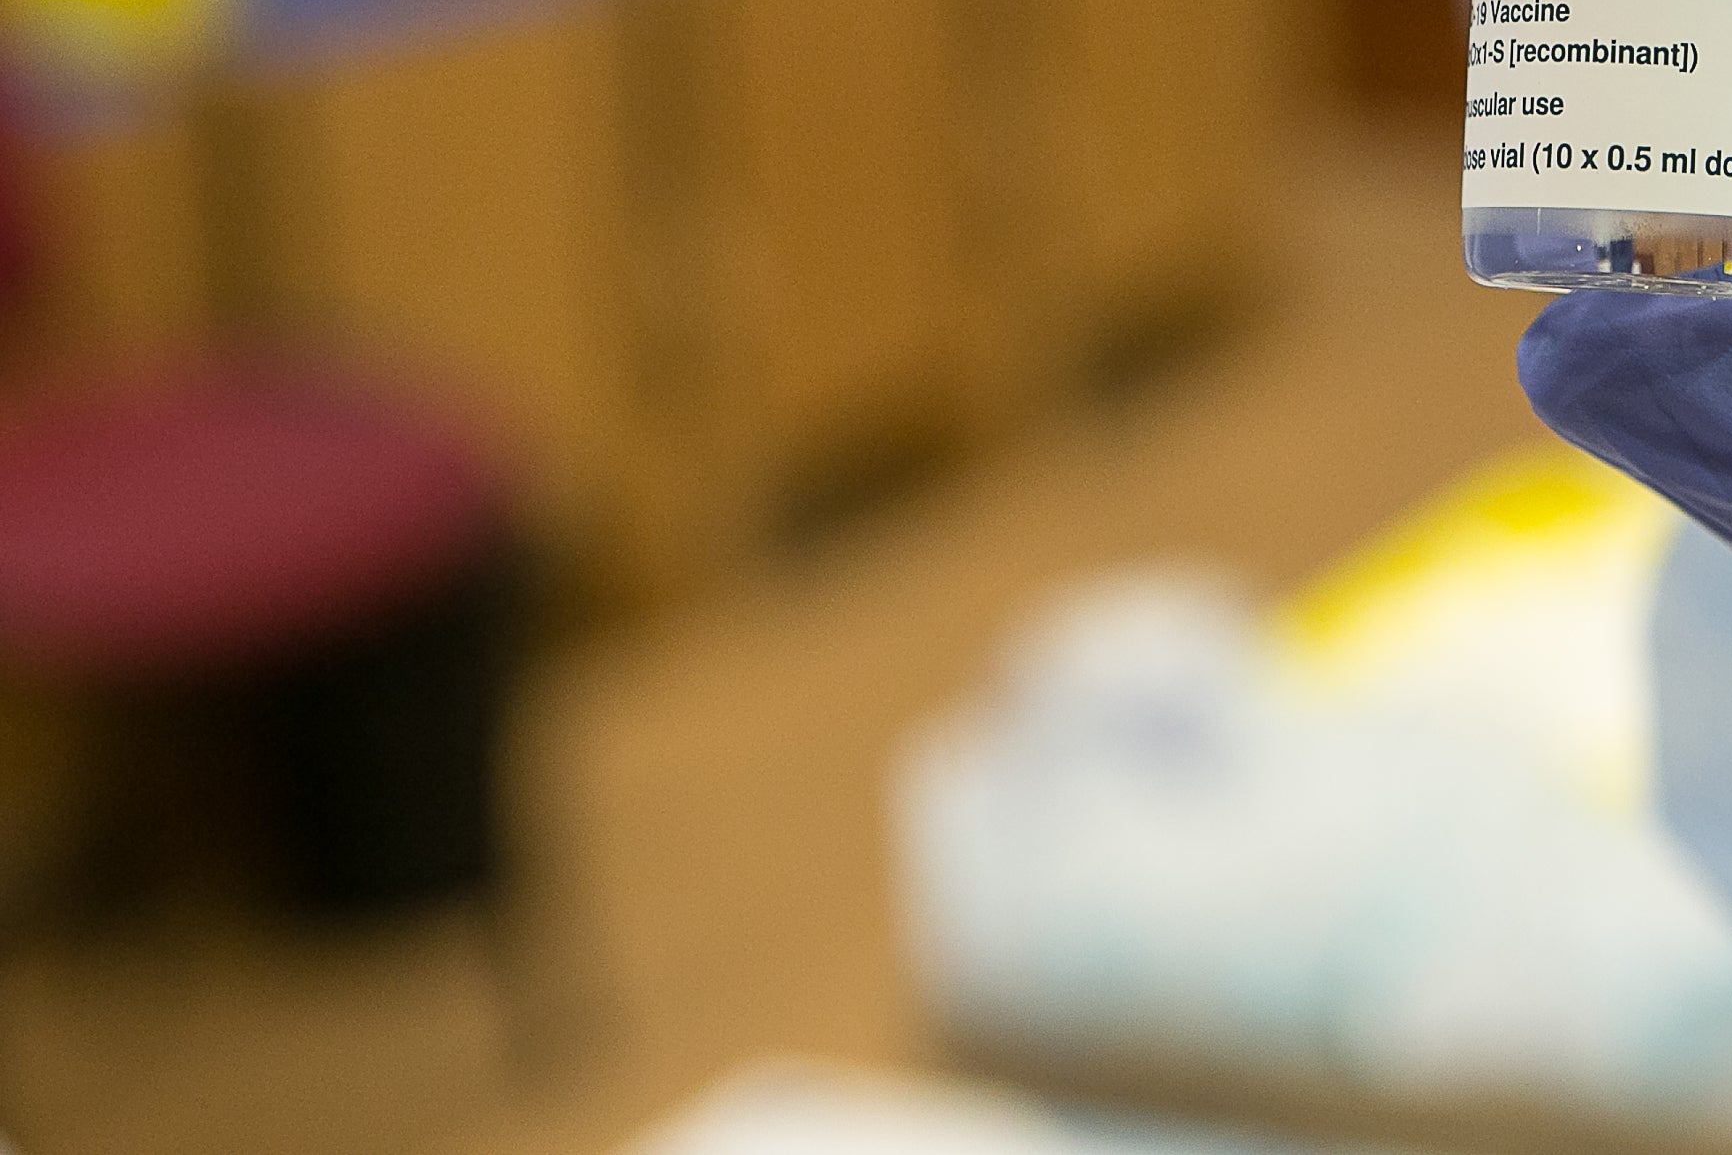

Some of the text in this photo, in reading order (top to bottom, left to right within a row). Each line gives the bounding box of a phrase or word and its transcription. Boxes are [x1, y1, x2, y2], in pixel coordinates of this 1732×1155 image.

[1471, 1, 1487, 25] -19
[1509, 39, 1699, 73] [recombinant])
[1467, 91, 1564, 117] uscular use
[1490, 142, 1525, 168] vial
[1532, 142, 1573, 175] (10
[1580, 148, 1599, 170] x
[1607, 145, 1652, 171] 0.5
[1661, 148, 1696, 174] ml
